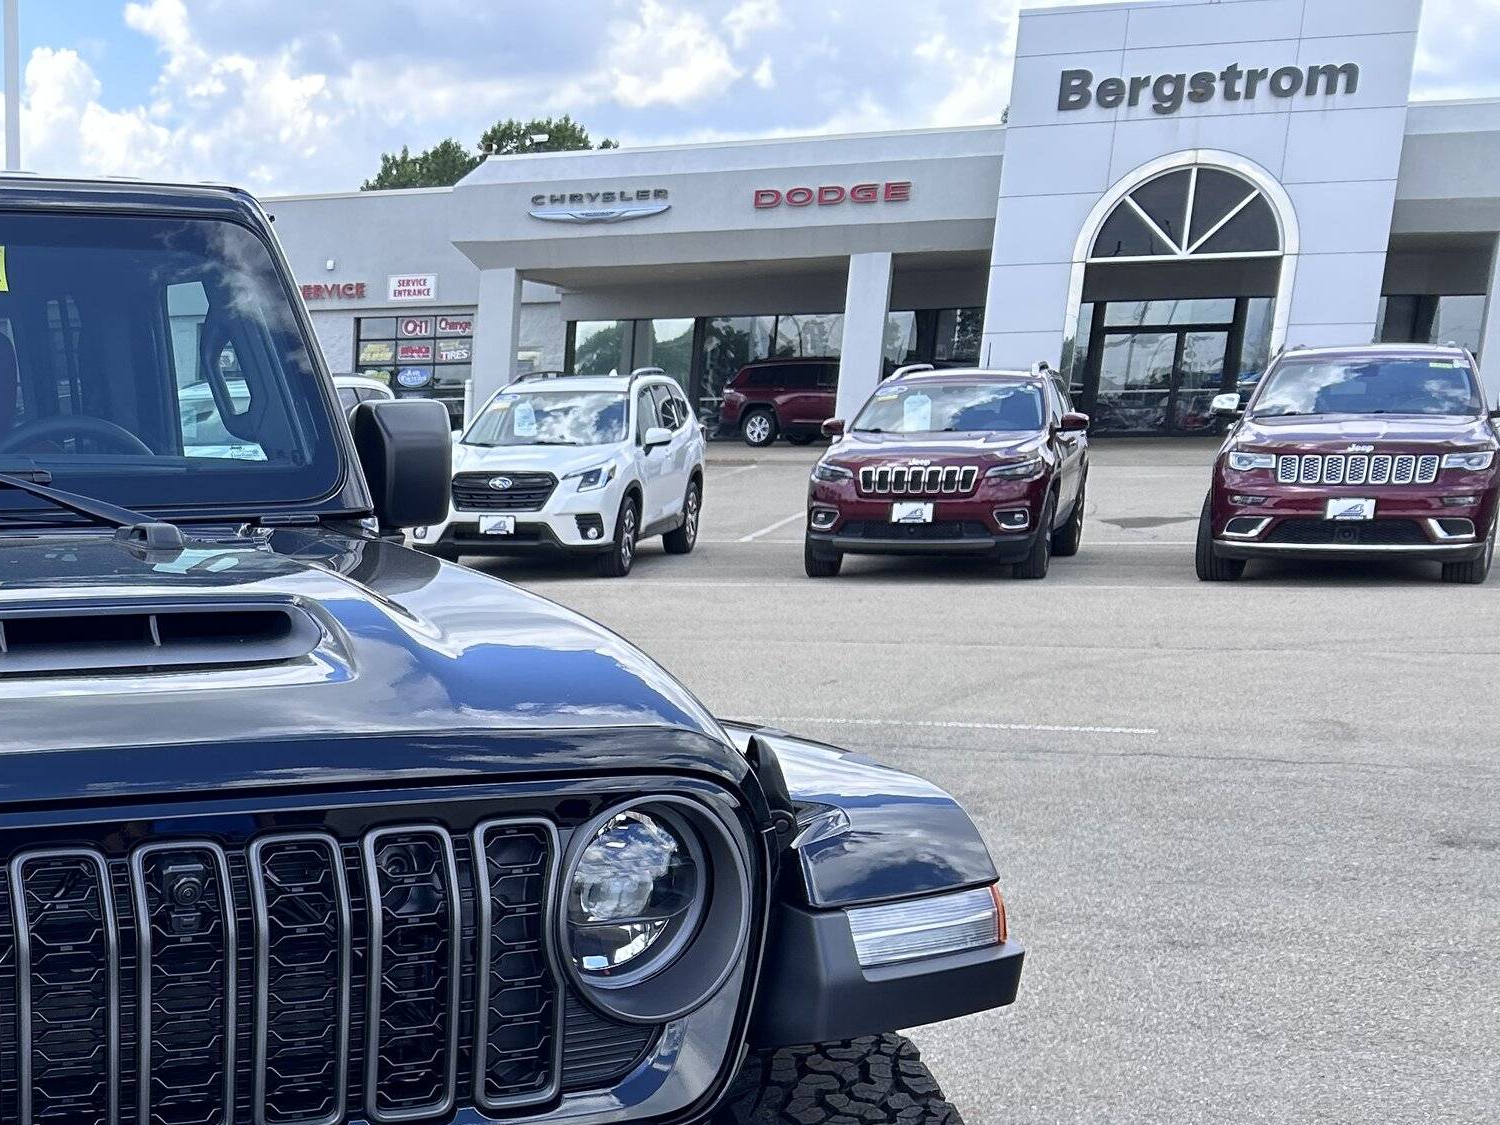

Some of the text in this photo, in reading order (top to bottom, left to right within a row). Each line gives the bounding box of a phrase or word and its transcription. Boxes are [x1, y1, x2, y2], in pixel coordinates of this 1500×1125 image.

[1057, 62, 1360, 114] Bergstrom
[531, 188, 670, 207] CHRYSLER
[753, 181, 912, 209] DODGE
[300, 282, 367, 301] ERVICE
[397, 278, 427, 288] SERVICE
[393, 288, 431, 298] ENTRANCE
[402, 317, 473, 336] Oil Change
[1347, 444, 1374, 453] Jeep
